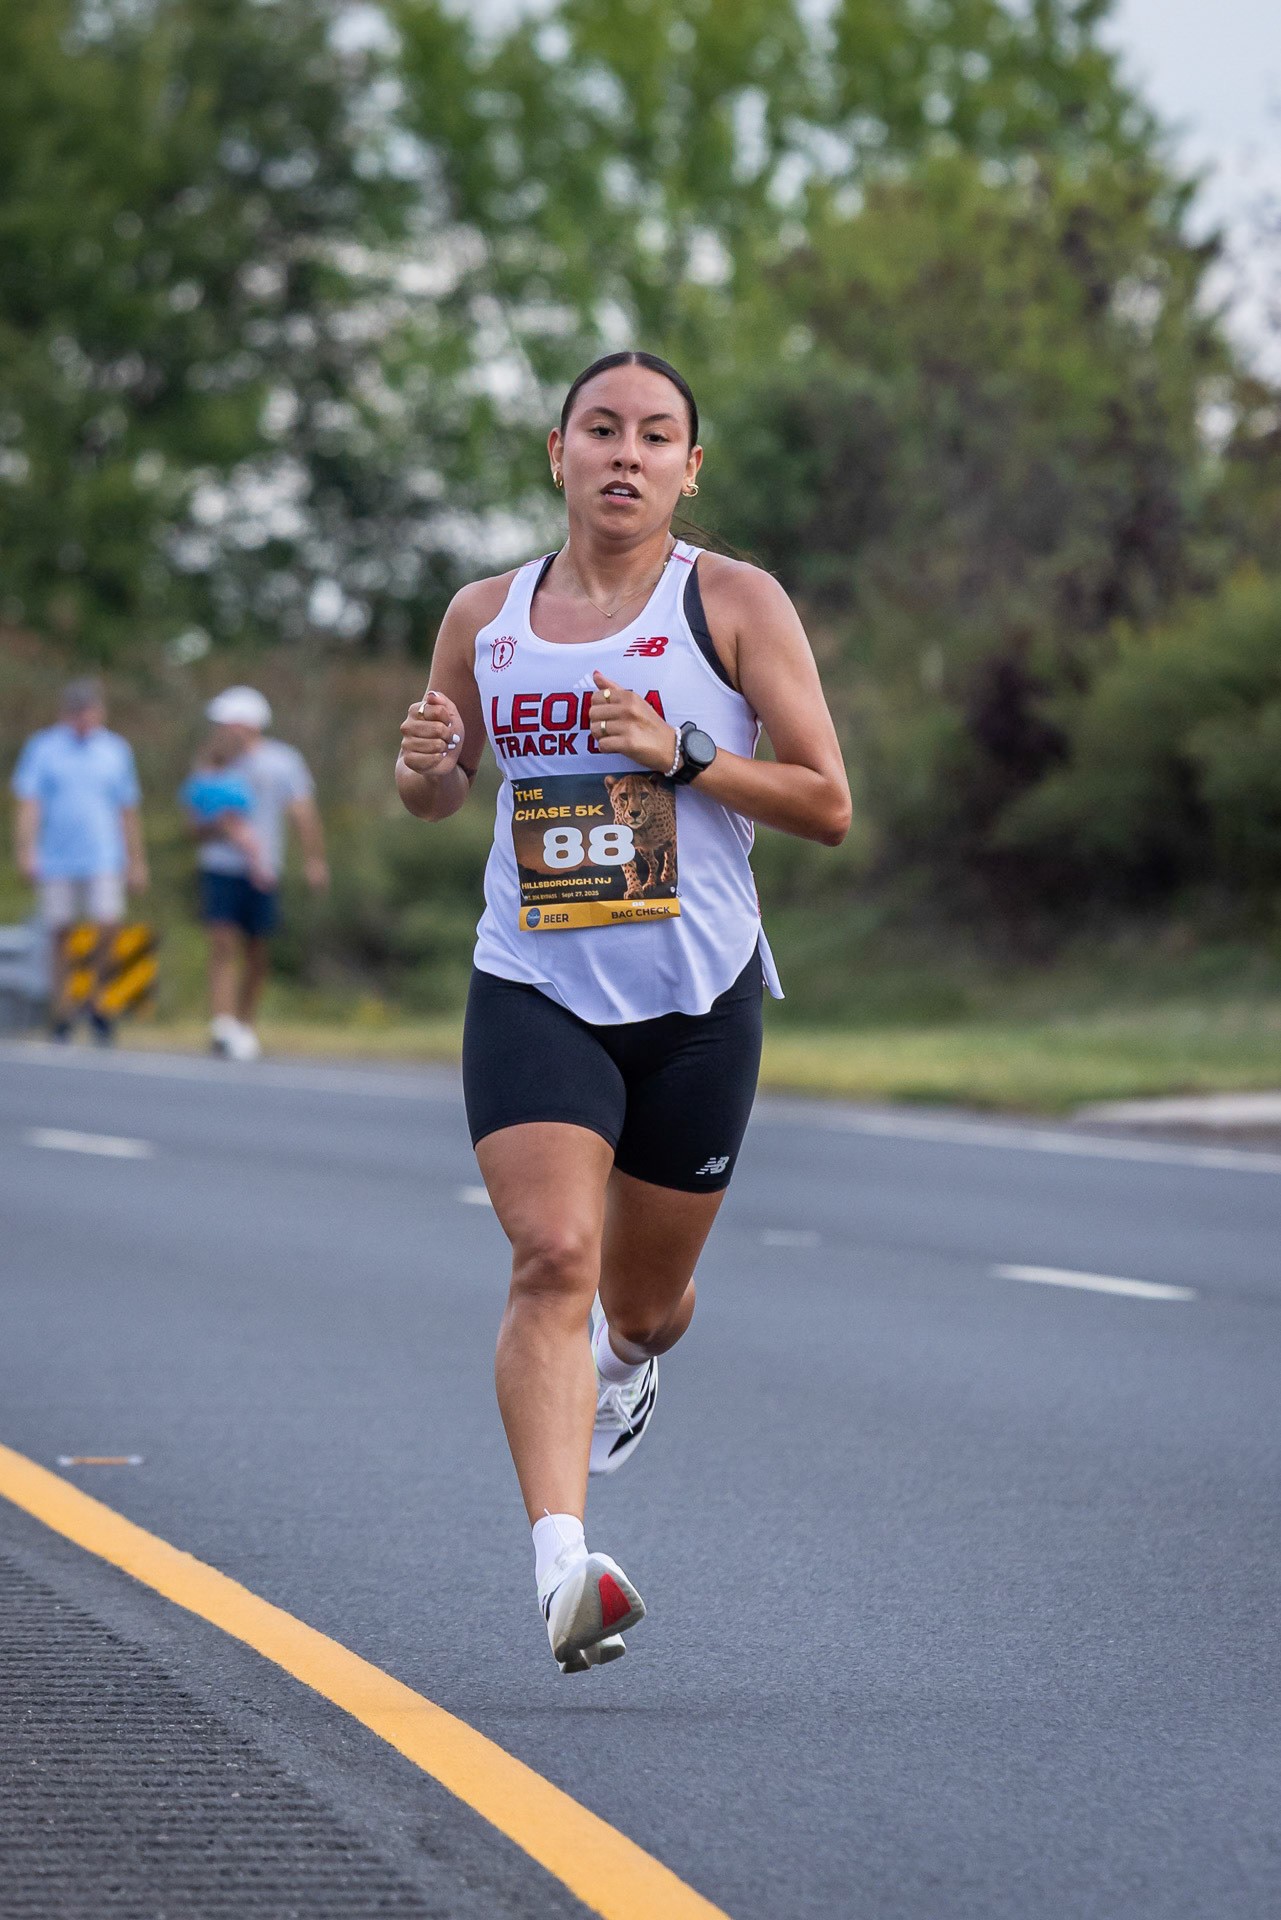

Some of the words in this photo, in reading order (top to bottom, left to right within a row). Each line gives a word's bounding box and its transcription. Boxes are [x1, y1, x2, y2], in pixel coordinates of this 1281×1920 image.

[491, 690, 666, 736] LEOA
[495, 733, 579, 760] TRACK
[514, 788, 544, 802] THE
[514, 806, 572, 821] CHASE
[575, 804, 605, 817] 5K
[543, 824, 636, 869] 88
[594, 876, 612, 885] NJ
[561, 891, 574, 899] Sept
[543, 914, 569, 924] BEER
[611, 910, 633, 919] BAG
[635, 906, 671, 917] CHECK
